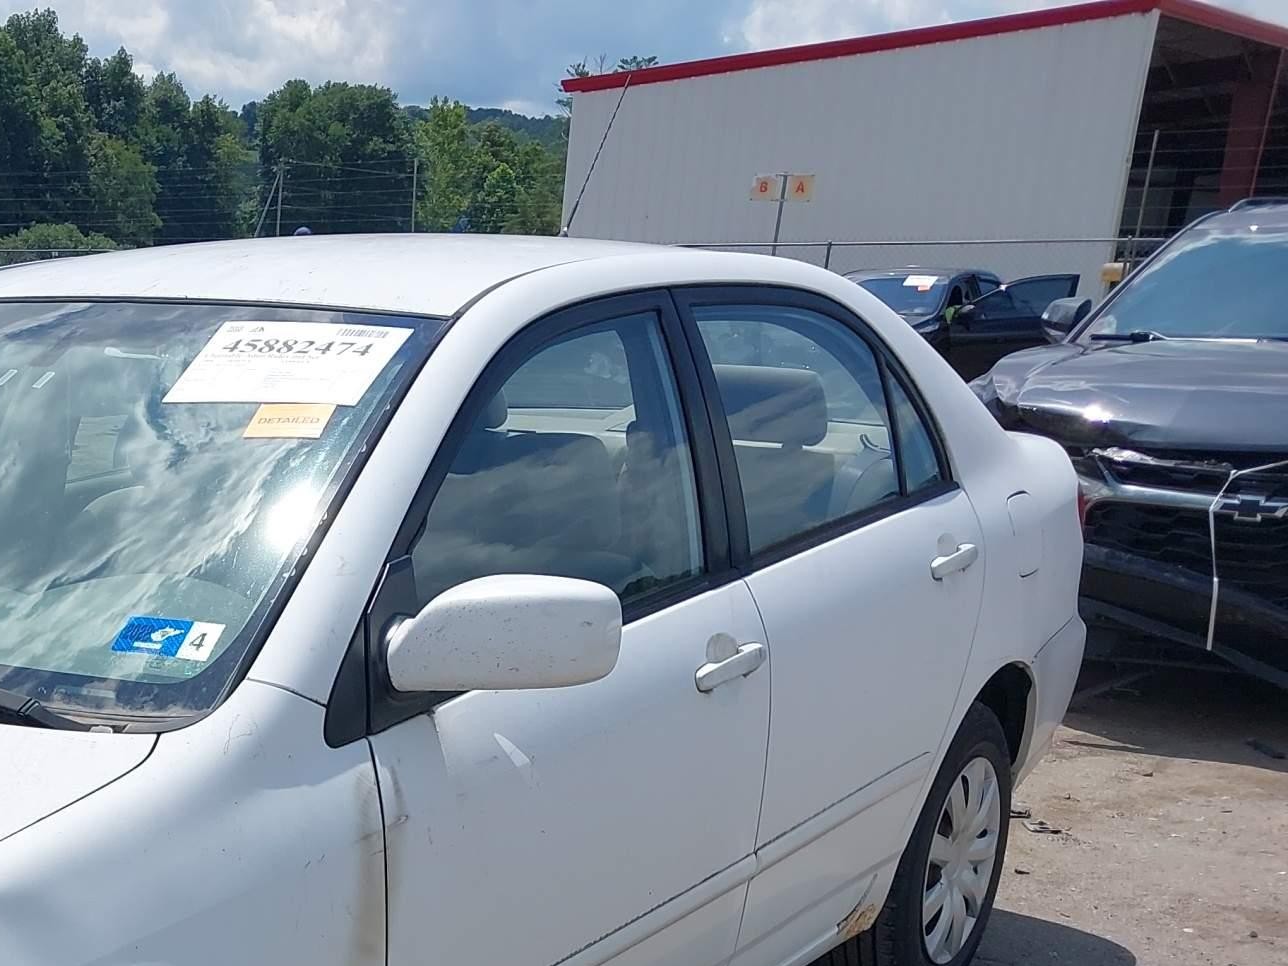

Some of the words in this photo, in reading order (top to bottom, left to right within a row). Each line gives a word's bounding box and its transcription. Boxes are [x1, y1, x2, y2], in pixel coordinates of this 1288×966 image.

[795, 181, 805, 193] A
[222, 338, 375, 357] 45882474
[257, 416, 321, 425] DETAILED
[189, 632, 208, 651] 4
